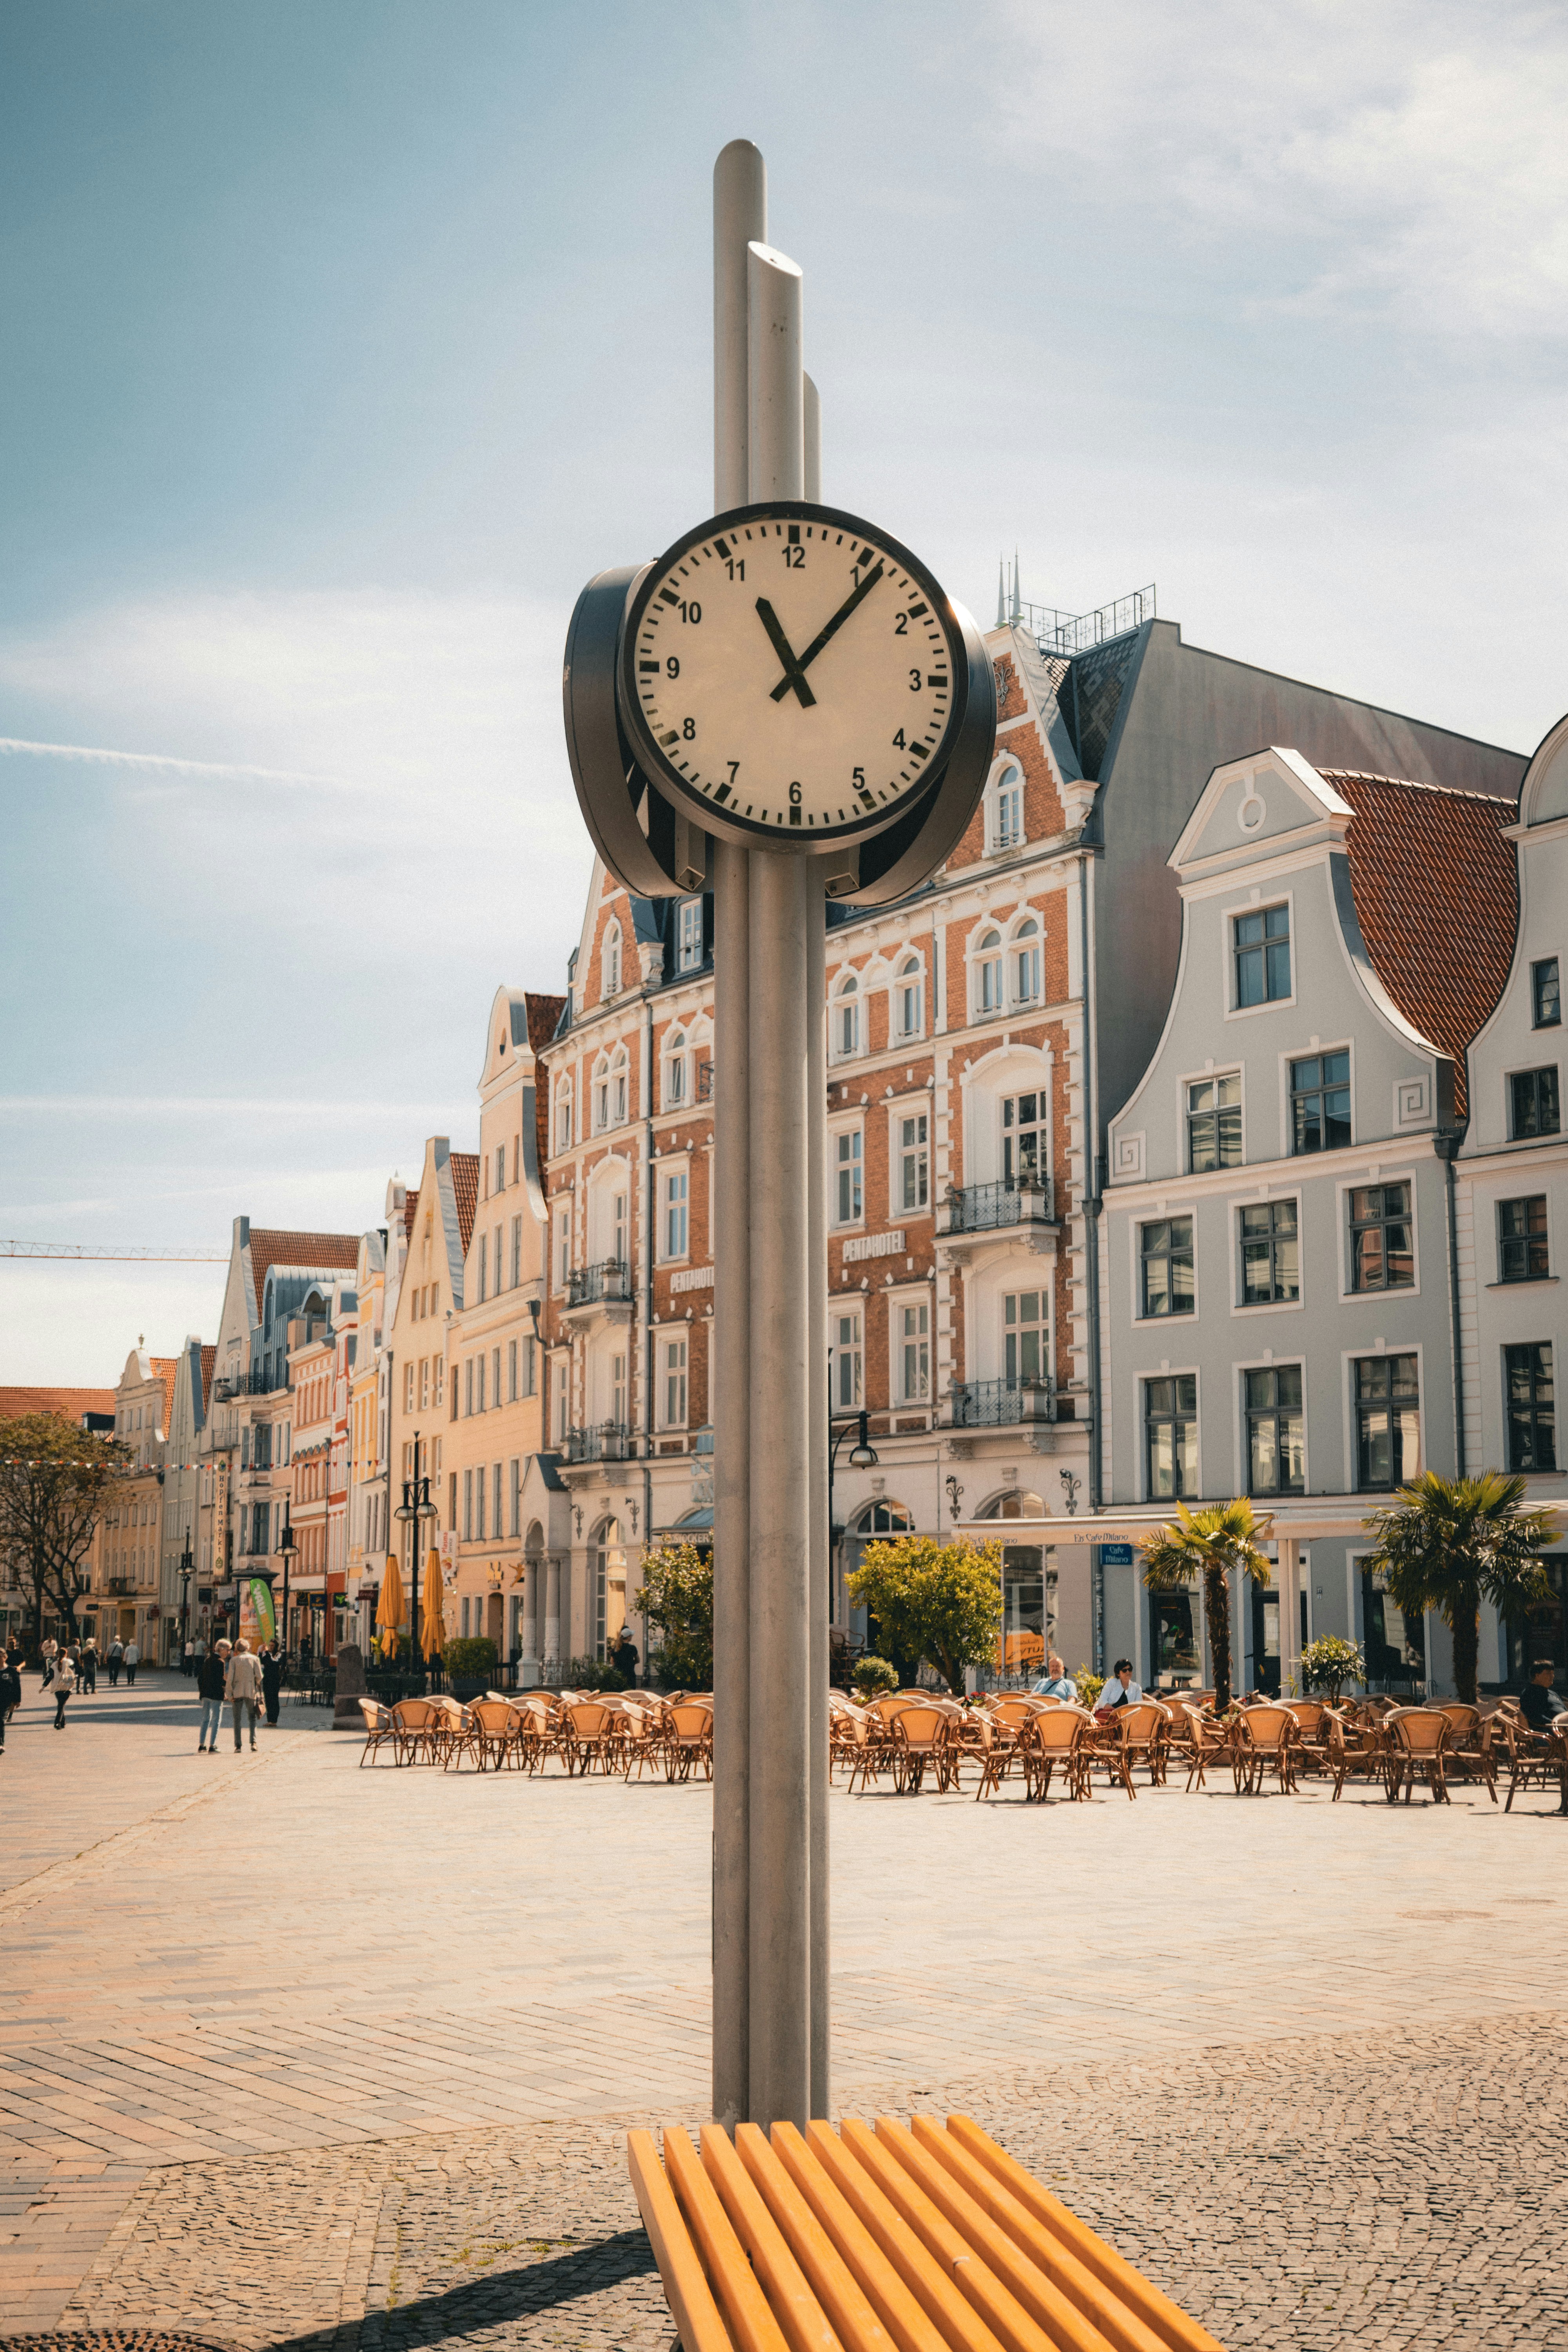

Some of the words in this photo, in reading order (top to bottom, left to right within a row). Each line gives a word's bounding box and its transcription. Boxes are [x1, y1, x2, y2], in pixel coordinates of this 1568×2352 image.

[782, 545, 805, 568] 12
[725, 560, 746, 581] 11
[678, 601, 701, 624] 10
[895, 612, 908, 635] 2
[667, 657, 679, 679] 9
[909, 669, 922, 691] 3
[683, 718, 695, 740] 8
[893, 728, 906, 750] 4
[727, 761, 740, 783] 7
[852, 767, 865, 790] 5
[789, 782, 802, 804] 6
[843, 1230, 906, 1263] PENTAHOTEL
[670, 1265, 714, 1294] PENTAHOT
[664, 1532, 709, 1544] OSTOCKER
[1074, 1534, 1084, 1543] Eis
[1086, 1533, 1102, 1542] Cafe
[1103, 1533, 1129, 1541] Milano
[1106, 1555, 1128, 1563] Milano
